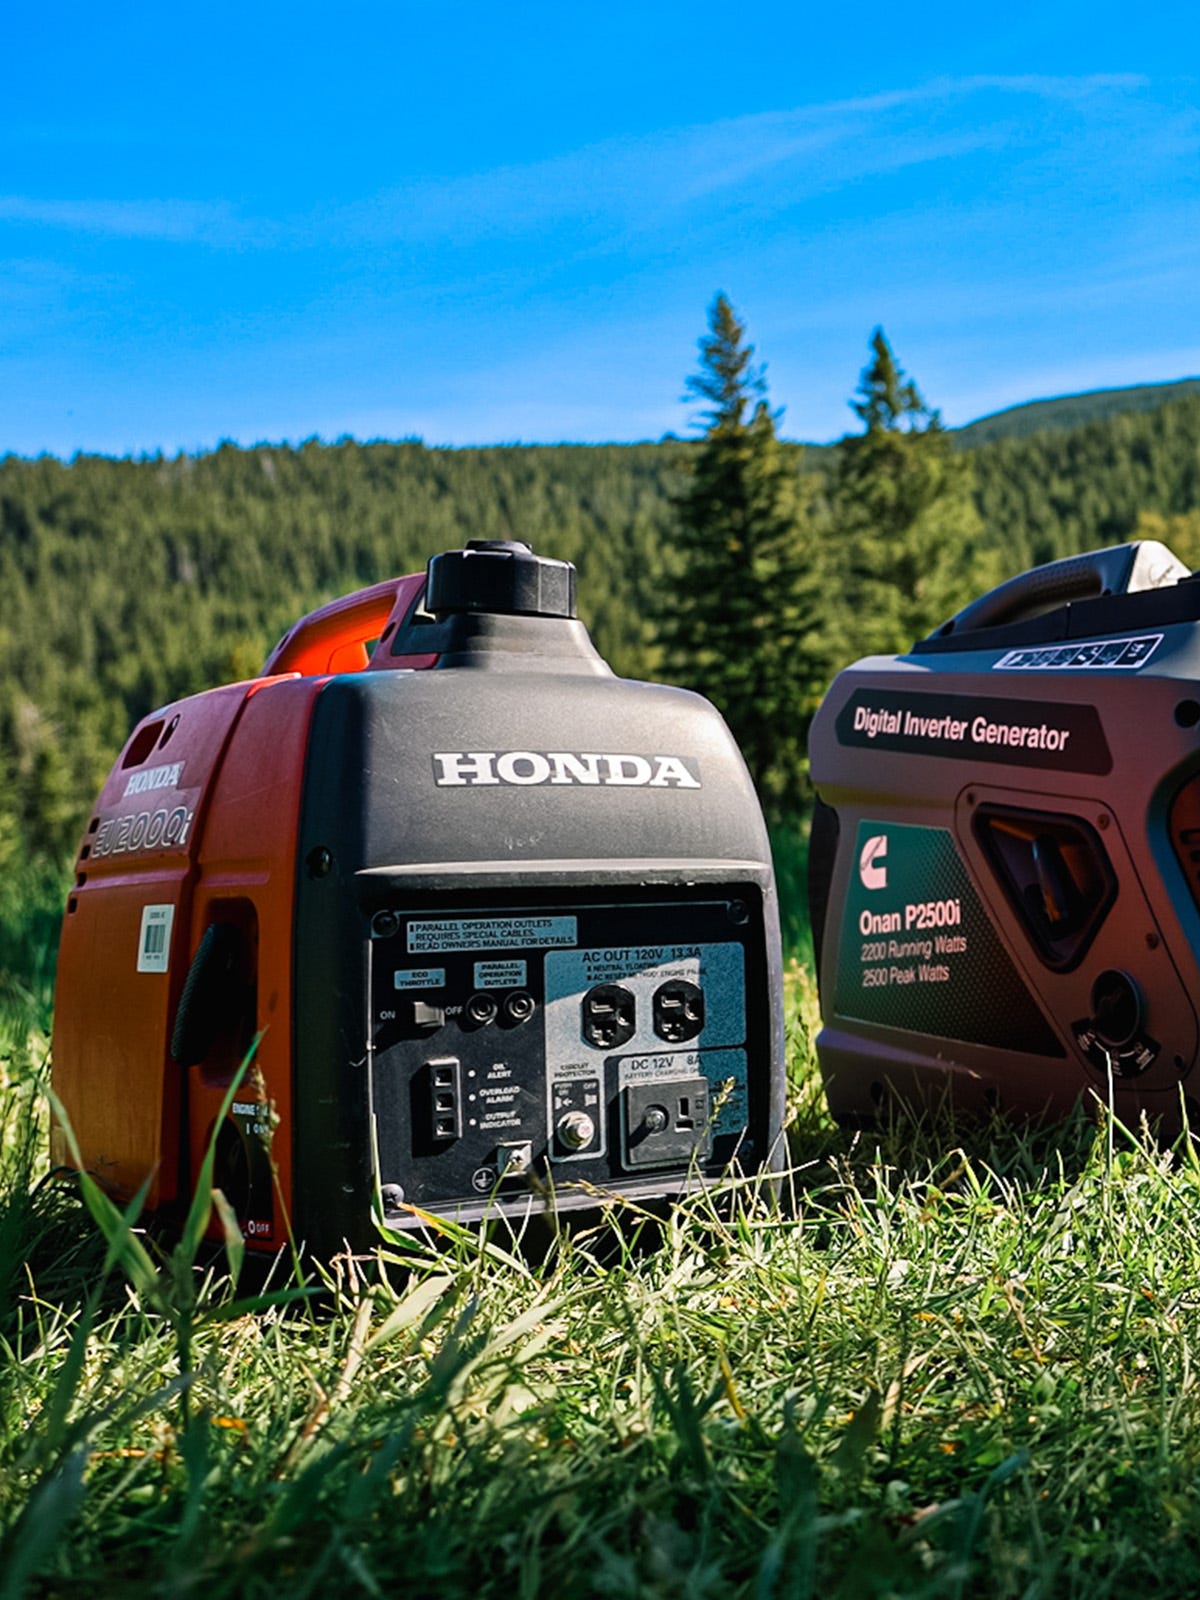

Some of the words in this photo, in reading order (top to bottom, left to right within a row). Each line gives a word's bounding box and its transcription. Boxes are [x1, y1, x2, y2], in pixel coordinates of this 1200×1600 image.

[854, 706, 902, 738] Digital
[904, 711, 968, 740] Inverter
[971, 717, 1070, 750] Generator
[434, 752, 701, 788] HONDA
[123, 763, 181, 797] HONDA
[91, 806, 193, 858] EU2000i
[860, 910, 901, 935] Onan
[905, 899, 960, 931] P2500i
[415, 922, 458, 932] PARALLEL
[462, 919, 512, 930] OPERATION
[515, 918, 553, 928] OUTLETS
[415, 932, 460, 942] REQUIRES
[464, 930, 498, 940] SPECIAL
[415, 942, 437, 950] READ
[483, 939, 519, 948] MANUAL
[522, 937, 537, 946] FOR
[862, 942, 886, 961] 2200
[888, 940, 932, 960] Running
[934, 935, 967, 954] Watts
[582, 951, 600, 963] AC
[603, 950, 630, 961] OUT
[636, 948, 663, 960] 120V
[672, 946, 702, 958] 13.3A
[479, 970, 522, 979] OPERATION
[863, 967, 888, 987] 2500
[890, 965, 915, 985] Peak
[918, 964, 950, 981] Watts
[400, 978, 440, 987] THROTTLE
[484, 978, 518, 987] OUTLETS
[380, 1010, 396, 1020] ON
[445, 1006, 463, 1016] OFF
[631, 1058, 648, 1071] DC
[653, 1055, 674, 1068] 12V
[487, 1070, 512, 1080] ALERT
[554, 1069, 596, 1079] PROTECTOR
[479, 1086, 520, 1097] OVERLOAD
[232, 1102, 256, 1116] ENGINE
[485, 1111, 517, 1121] OUTPUT
[480, 1119, 522, 1130] INDICATOR
[256, 1223, 269, 1233] OFF
